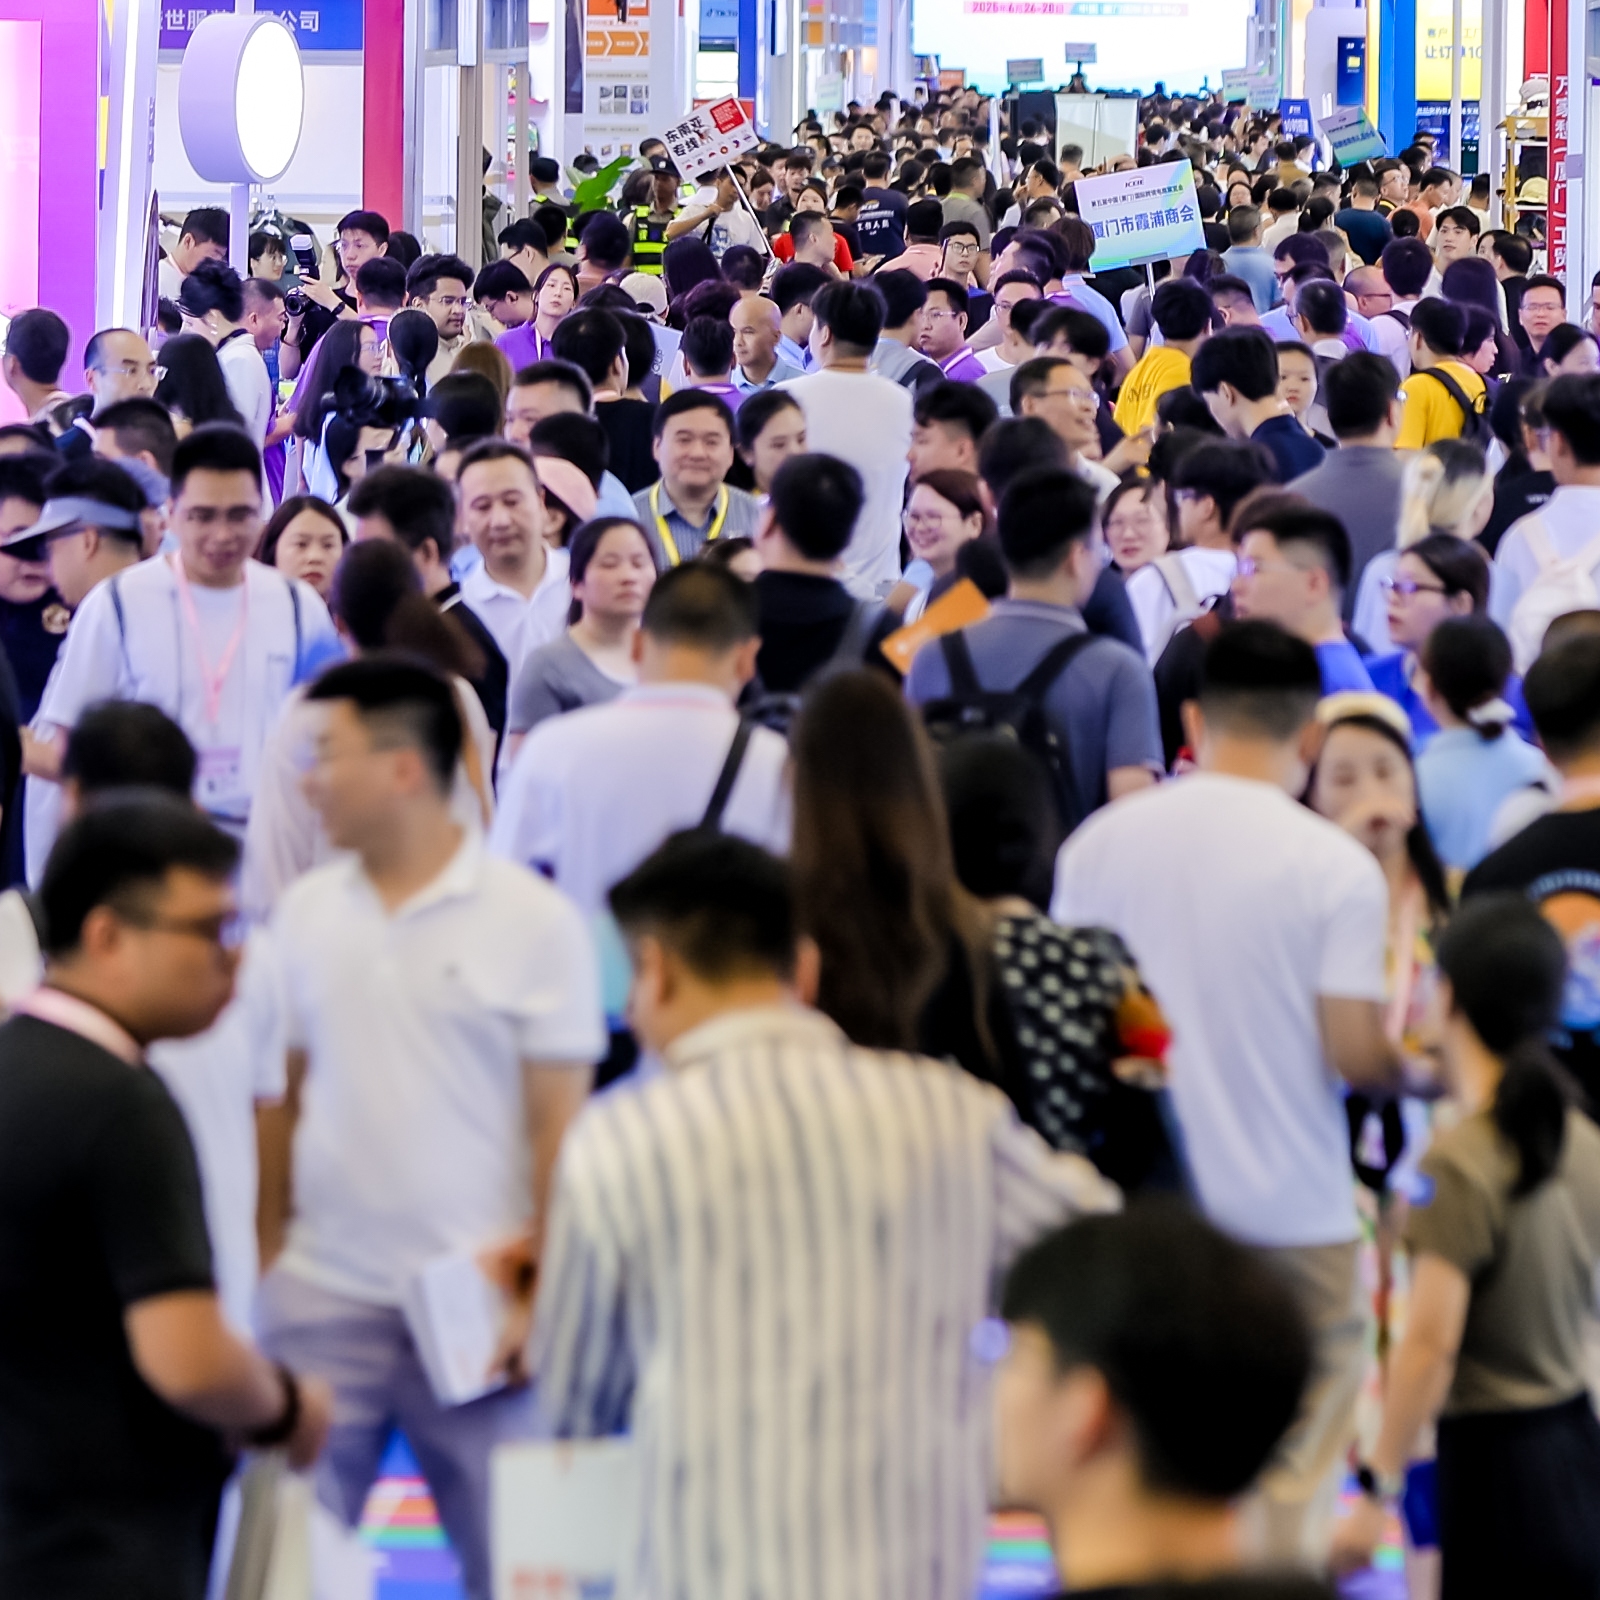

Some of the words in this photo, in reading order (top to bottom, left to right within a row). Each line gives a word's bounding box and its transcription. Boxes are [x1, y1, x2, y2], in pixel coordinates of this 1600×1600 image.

[665, 115, 704, 145] 东南亚
[1090, 204, 1195, 240] 厦门市霞浦商会
